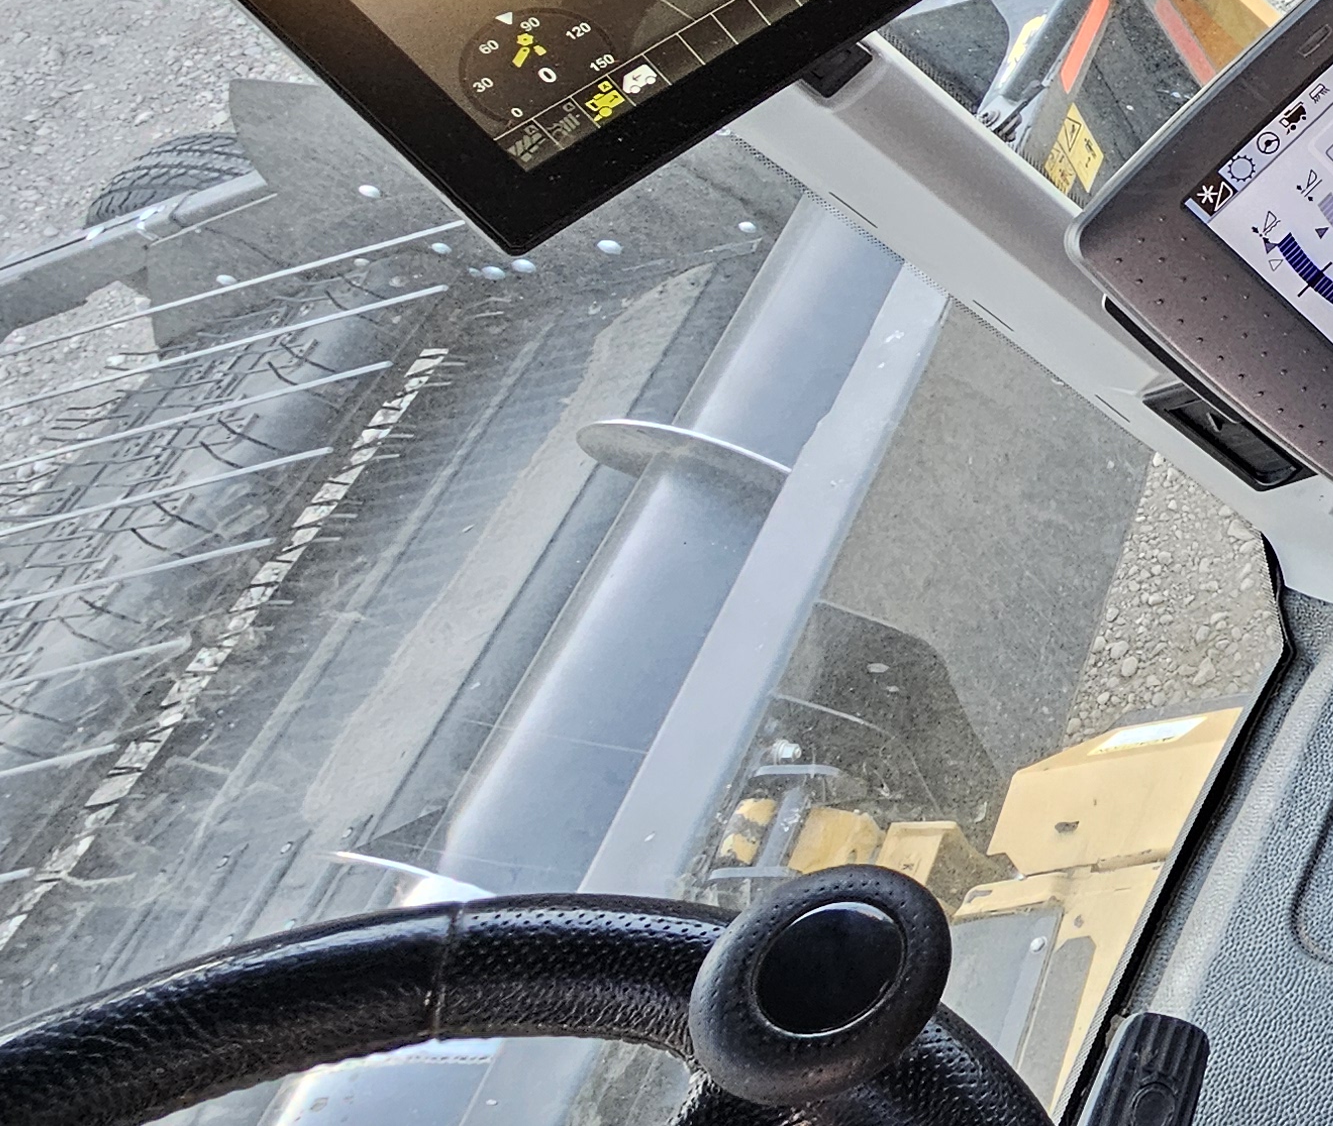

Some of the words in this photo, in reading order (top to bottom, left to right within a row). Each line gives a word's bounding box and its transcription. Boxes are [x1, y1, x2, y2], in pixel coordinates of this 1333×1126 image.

[520, 16, 540, 32] 90
[565, 22, 592, 41] 120
[478, 39, 499, 55] 60
[589, 53, 615, 73] 150
[538, 67, 558, 84] 0
[472, 77, 494, 94] 30
[510, 107, 524, 119] 0
